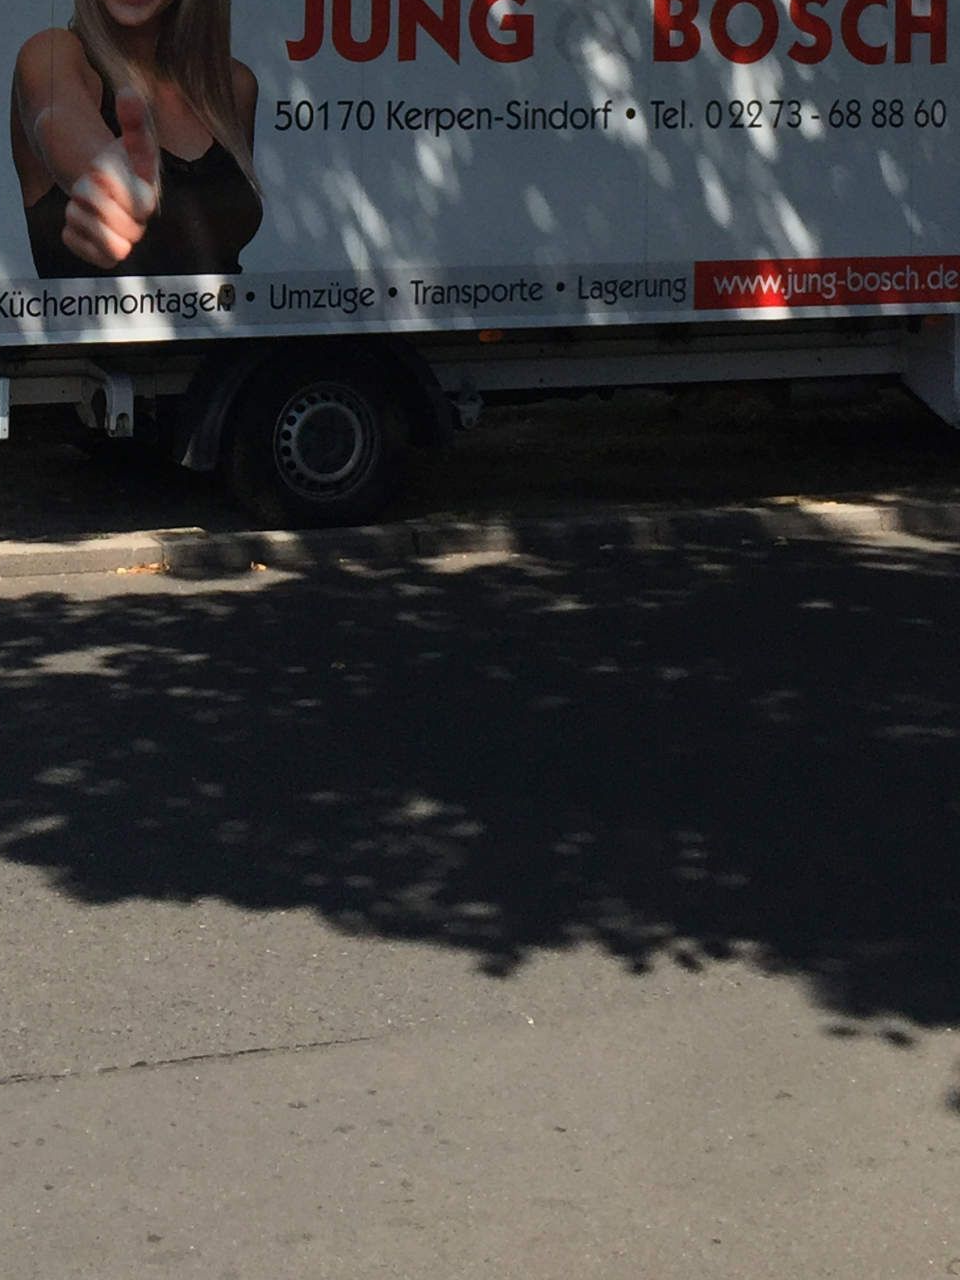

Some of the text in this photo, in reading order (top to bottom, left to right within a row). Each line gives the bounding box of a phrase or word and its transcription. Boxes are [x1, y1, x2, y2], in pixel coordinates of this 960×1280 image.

[274, 100, 375, 131] 50170
[387, 99, 612, 137] Kerpen-Sindorf
[651, 100, 694, 130] Tel.
[828, 99, 861, 130] 68
[871, 99, 904, 130] 88
[914, 99, 947, 130] 60
[270, 284, 375, 314] Umzüge
[411, 277, 543, 308] Transporte
[578, 275, 687, 304] Lagerung
[714, 264, 959, 300] www.jung-bosch.de
